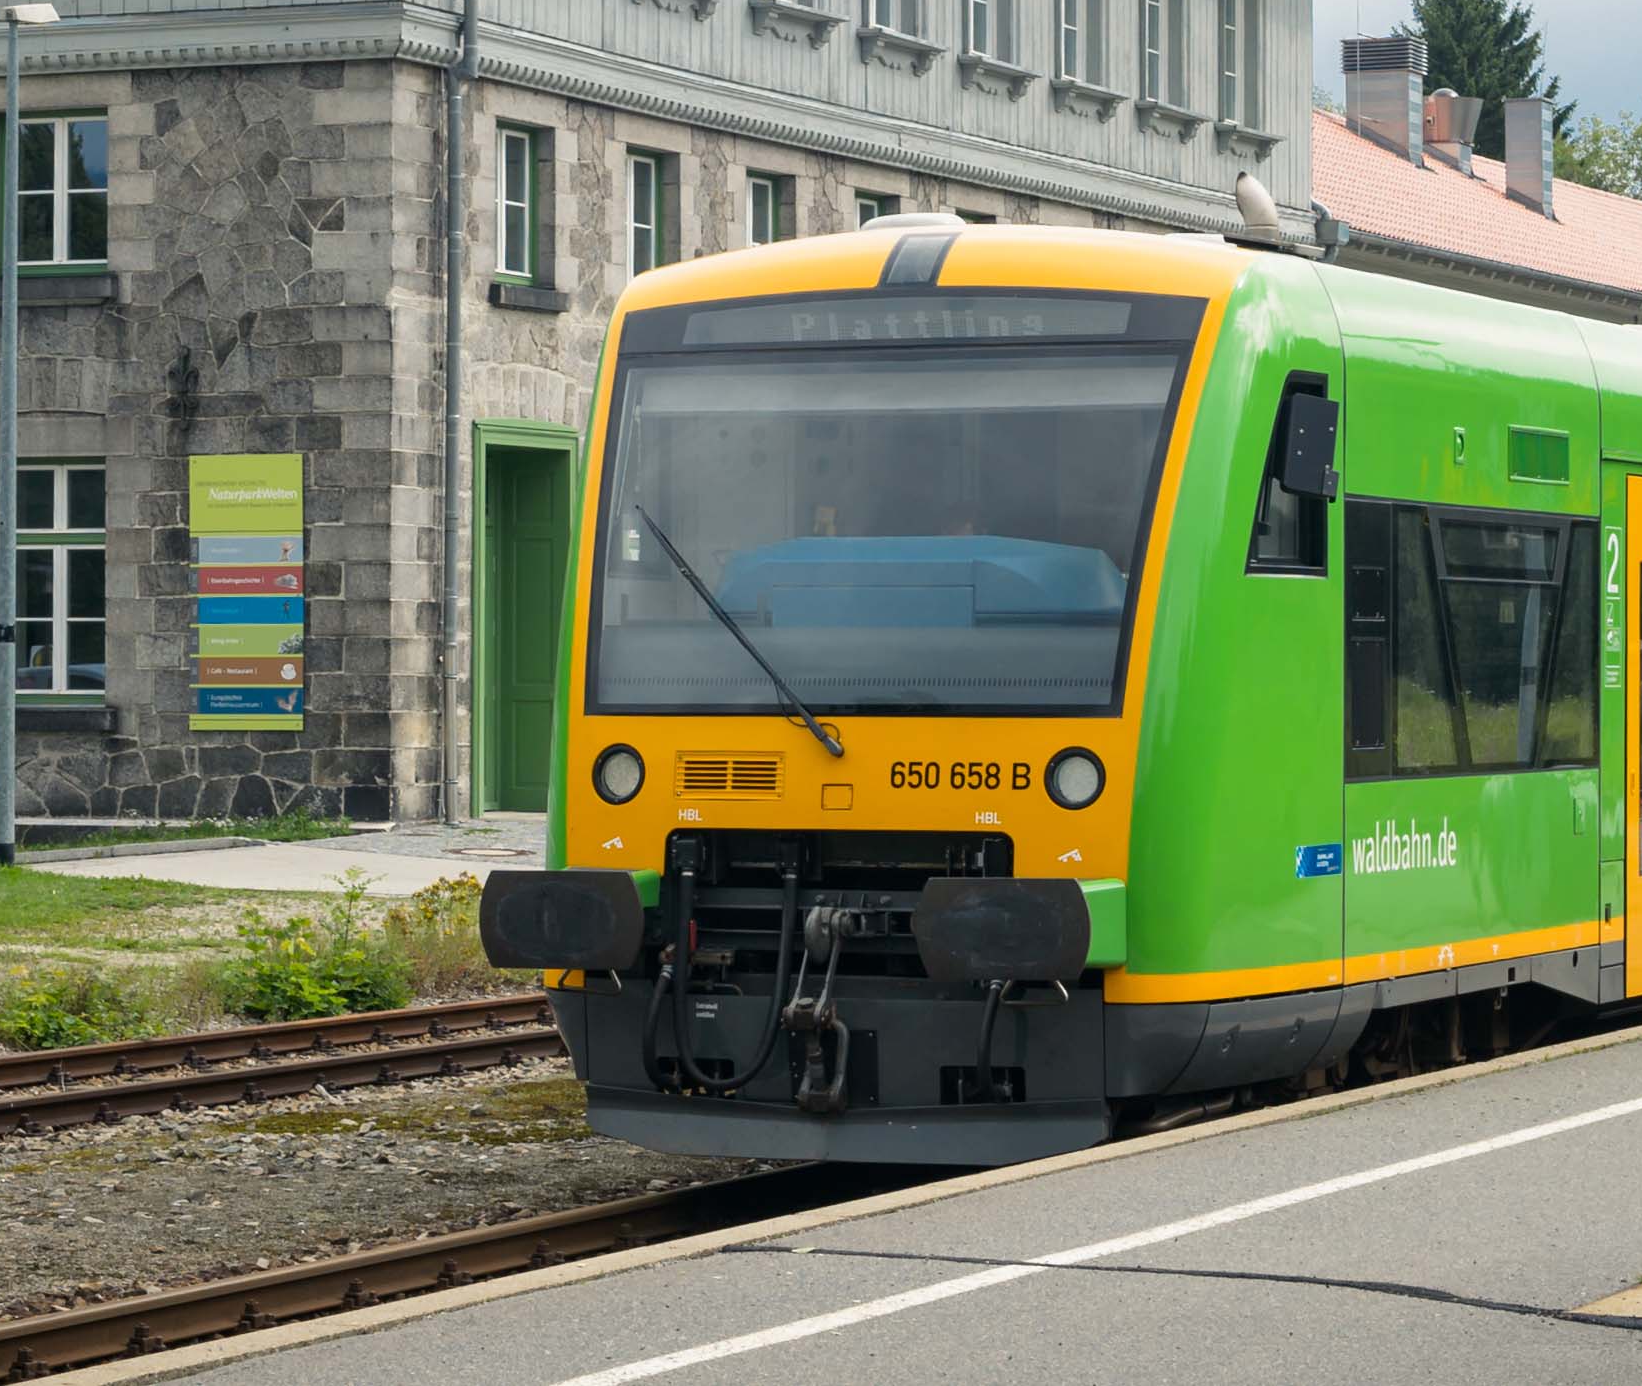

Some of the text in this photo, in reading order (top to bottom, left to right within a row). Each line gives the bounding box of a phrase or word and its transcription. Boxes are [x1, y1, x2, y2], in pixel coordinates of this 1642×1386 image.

[1607, 533, 1619, 593] 2
[890, 761, 1032, 791] 650 658 B
[678, 809, 703, 822] HBL
[975, 812, 1002, 825] HBL
[1352, 816, 1457, 875] waldbahn.de
